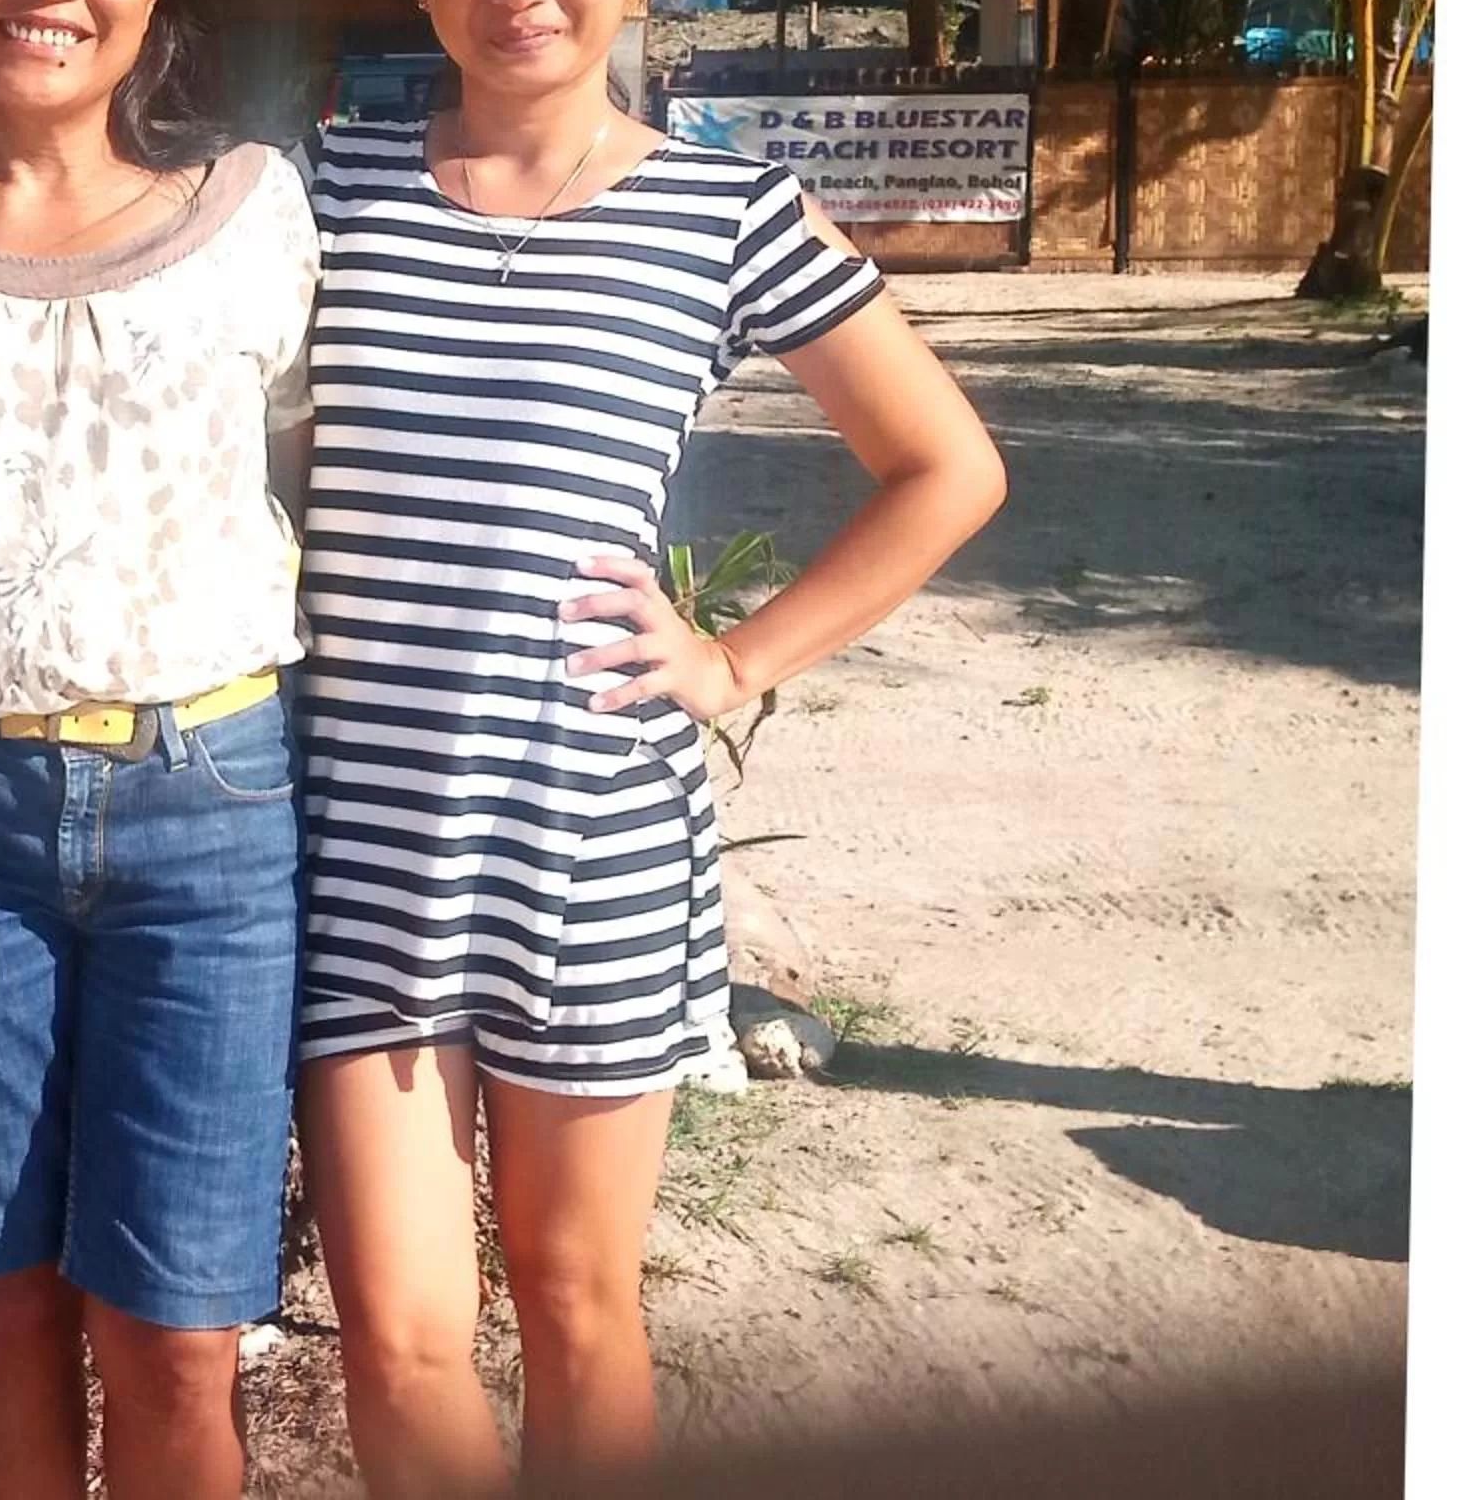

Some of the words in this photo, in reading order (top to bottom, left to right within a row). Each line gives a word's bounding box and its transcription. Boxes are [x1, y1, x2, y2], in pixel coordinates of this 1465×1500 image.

[759, 109, 783, 129] D
[790, 109, 815, 129] &
[824, 109, 846, 129] B
[854, 107, 1026, 129] BLUESTAR
[764, 139, 879, 161] BEACH
[888, 139, 1020, 160] RESORT
